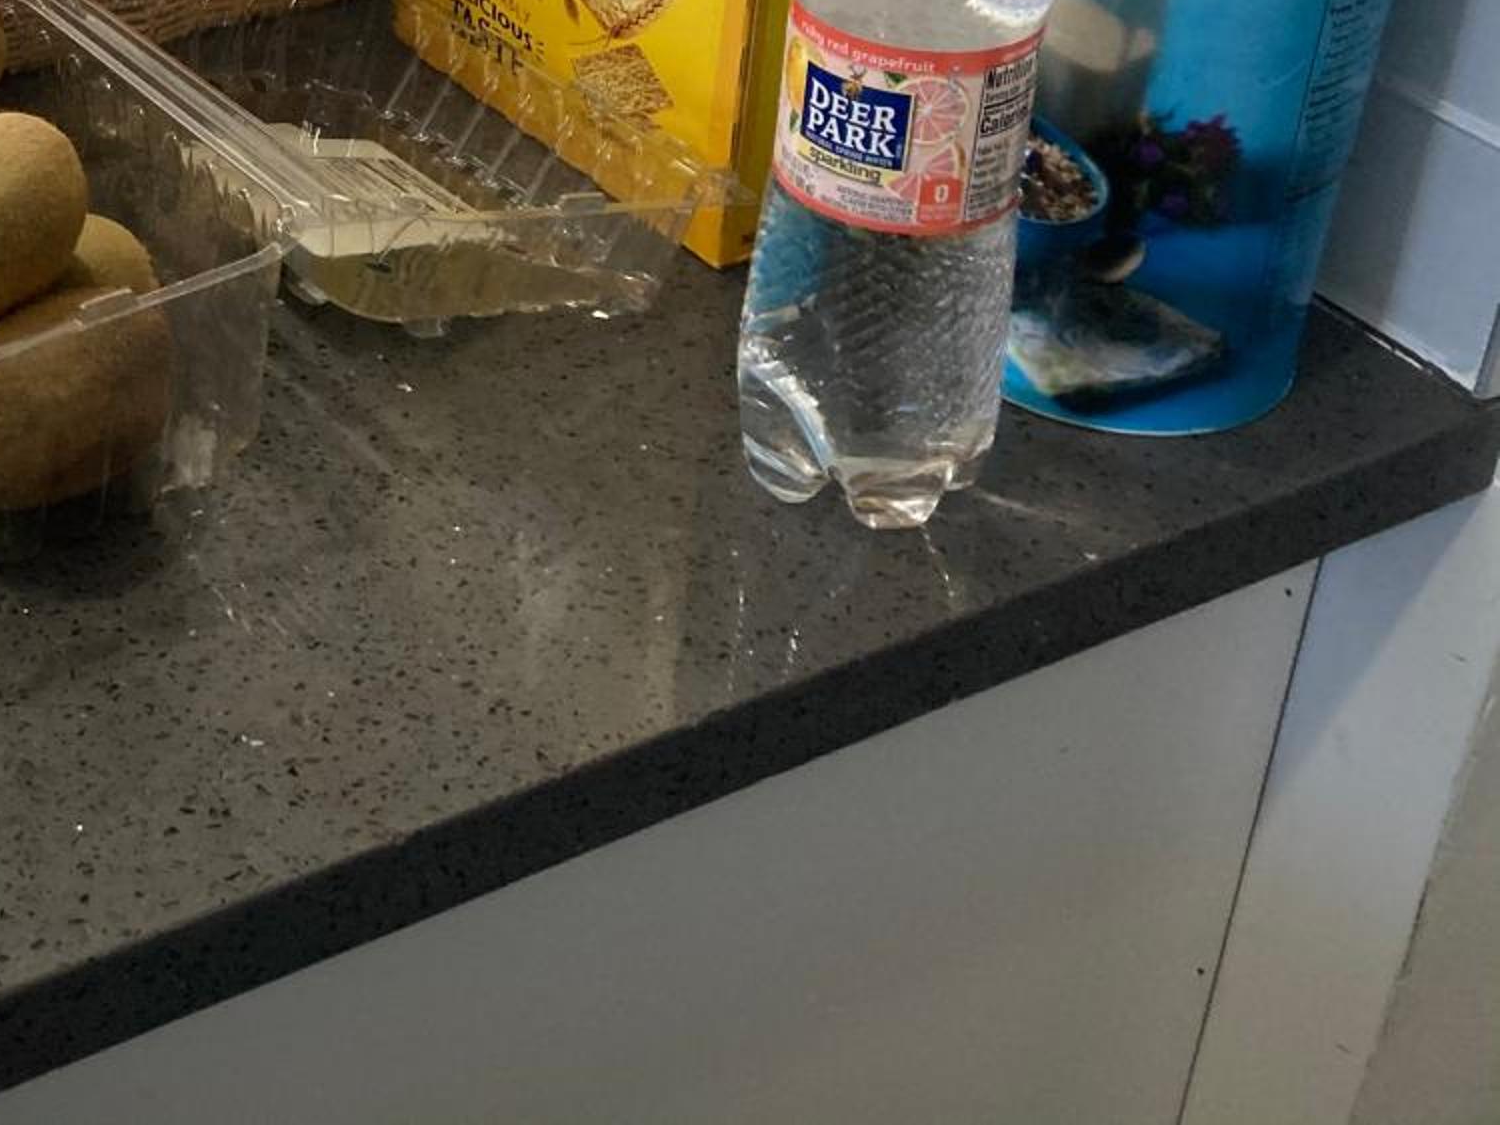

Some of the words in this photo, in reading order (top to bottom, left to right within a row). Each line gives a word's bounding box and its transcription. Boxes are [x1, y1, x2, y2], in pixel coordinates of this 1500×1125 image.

[825, 36, 850, 58] red
[852, 47, 936, 73] grapefruit
[809, 75, 898, 134] DEER
[806, 108, 897, 159] PARK
[809, 146, 881, 183] sparkling
